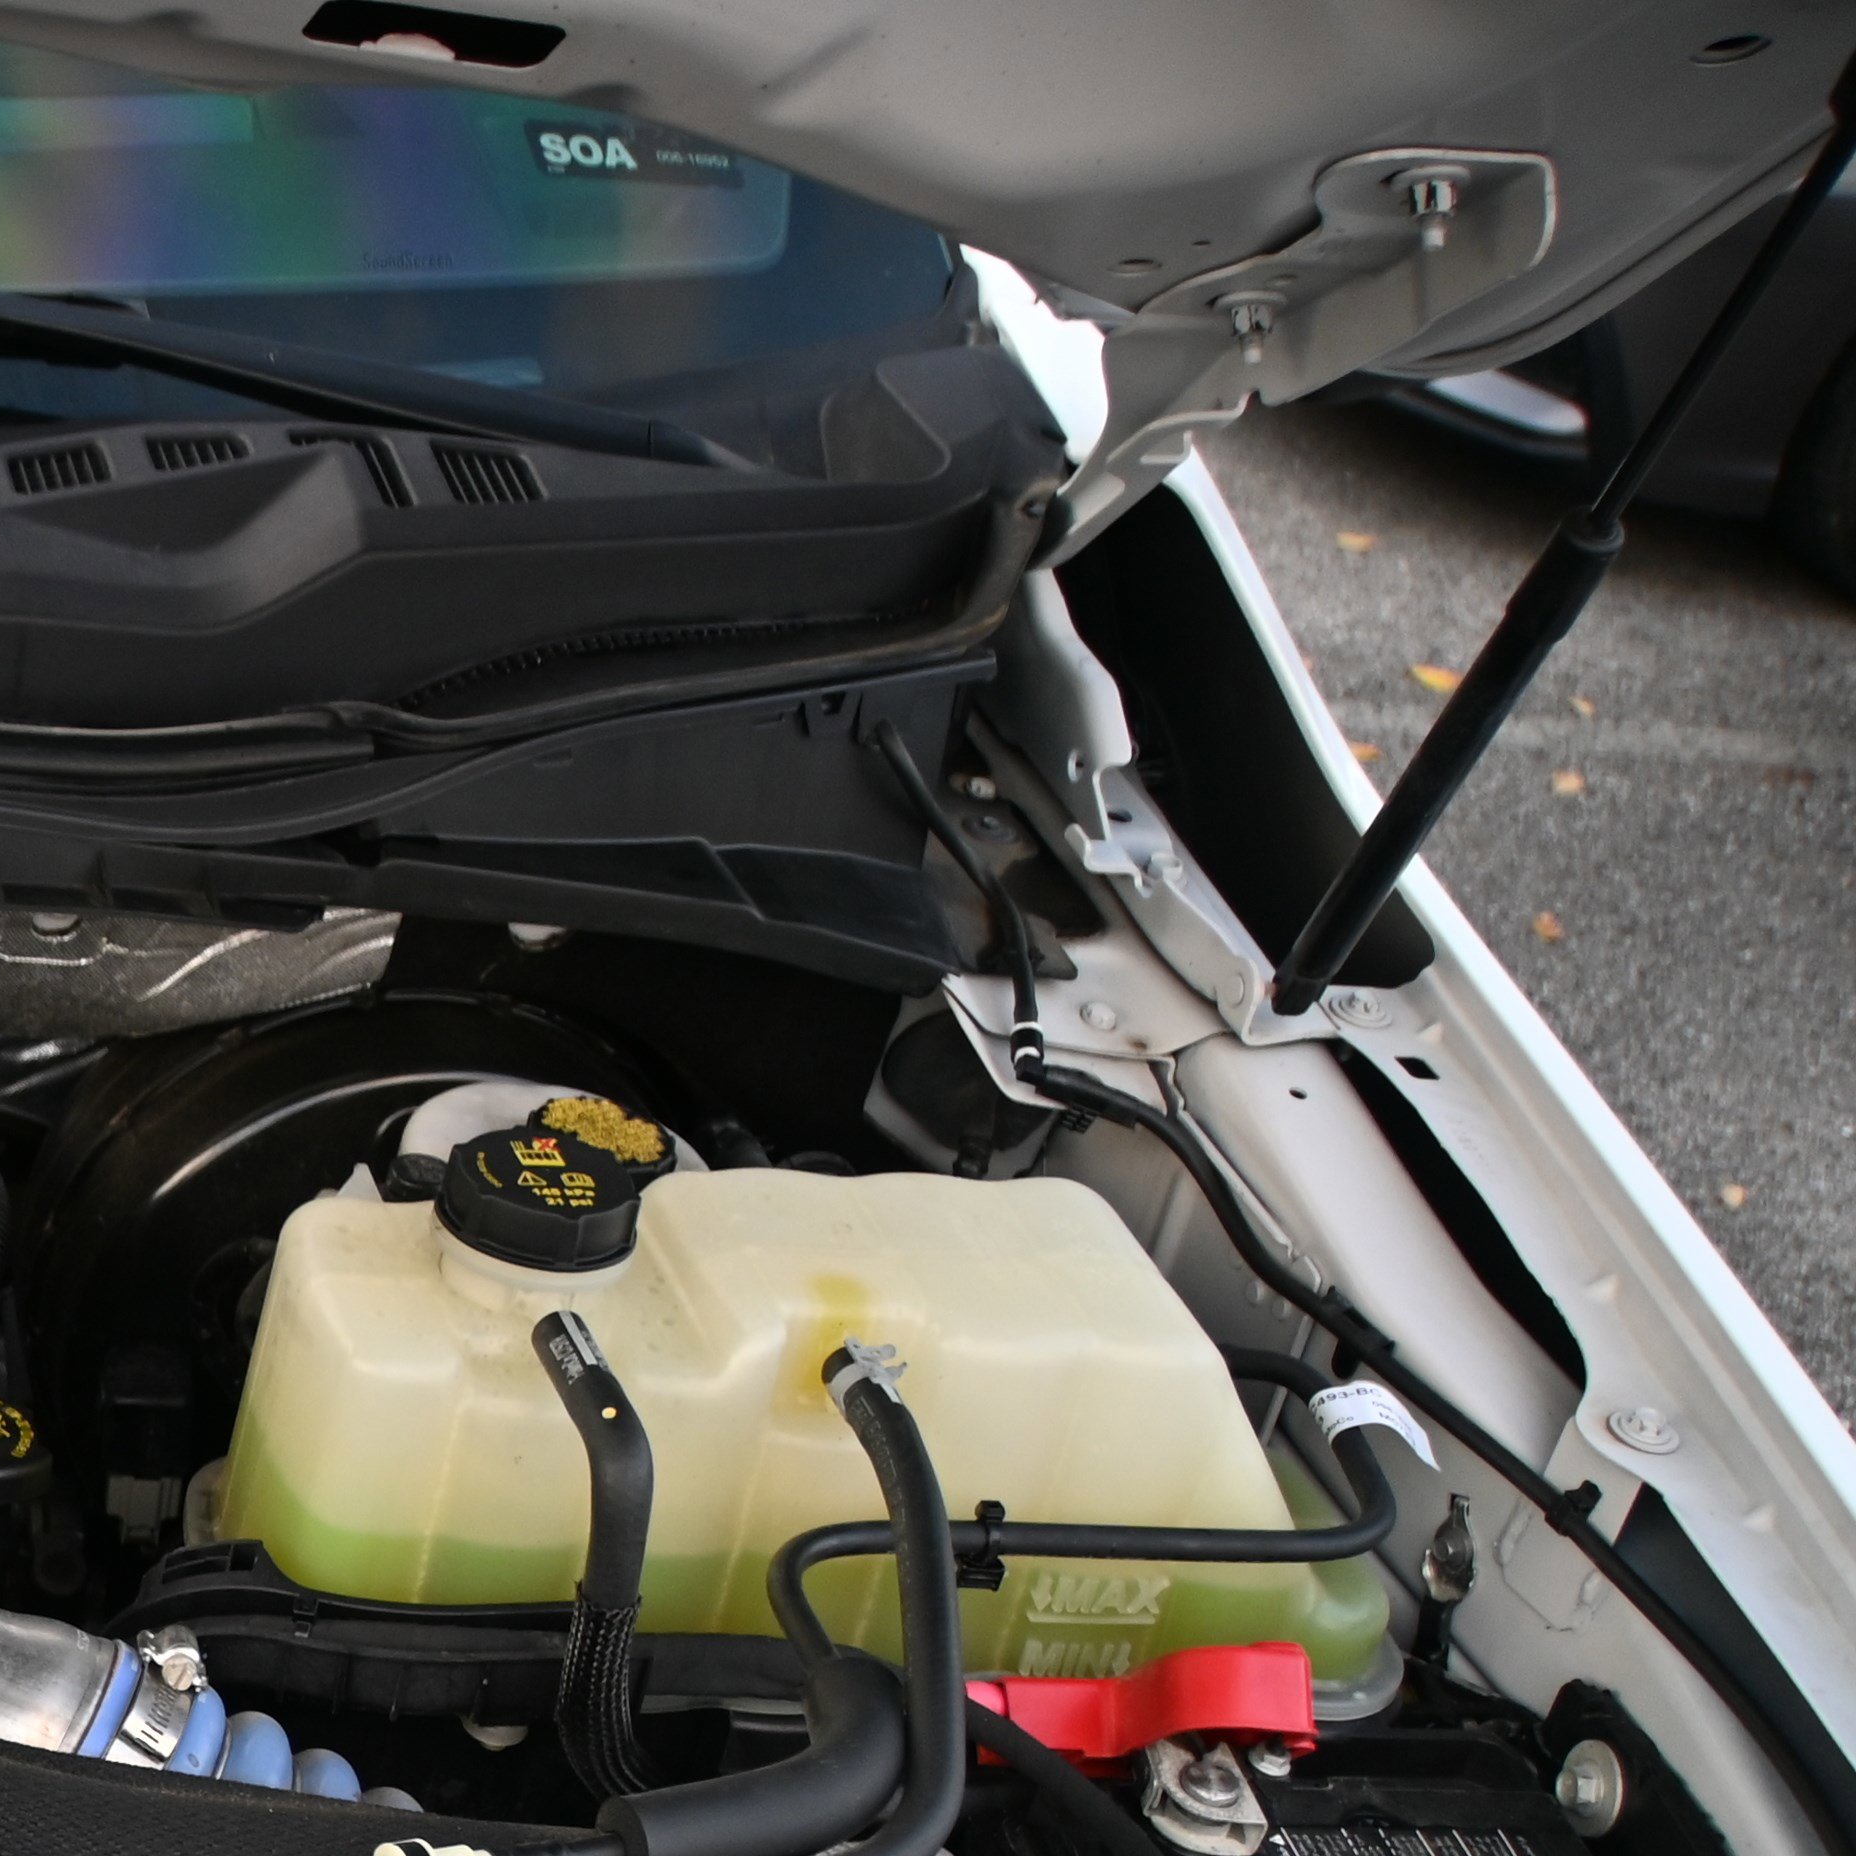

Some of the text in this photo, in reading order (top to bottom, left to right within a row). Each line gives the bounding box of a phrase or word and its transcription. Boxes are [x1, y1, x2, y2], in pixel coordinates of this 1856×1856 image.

[540, 133, 637, 170] SOA
[1052, 1576, 1170, 1614] MAX
[1019, 1639, 1114, 1678] MIN
